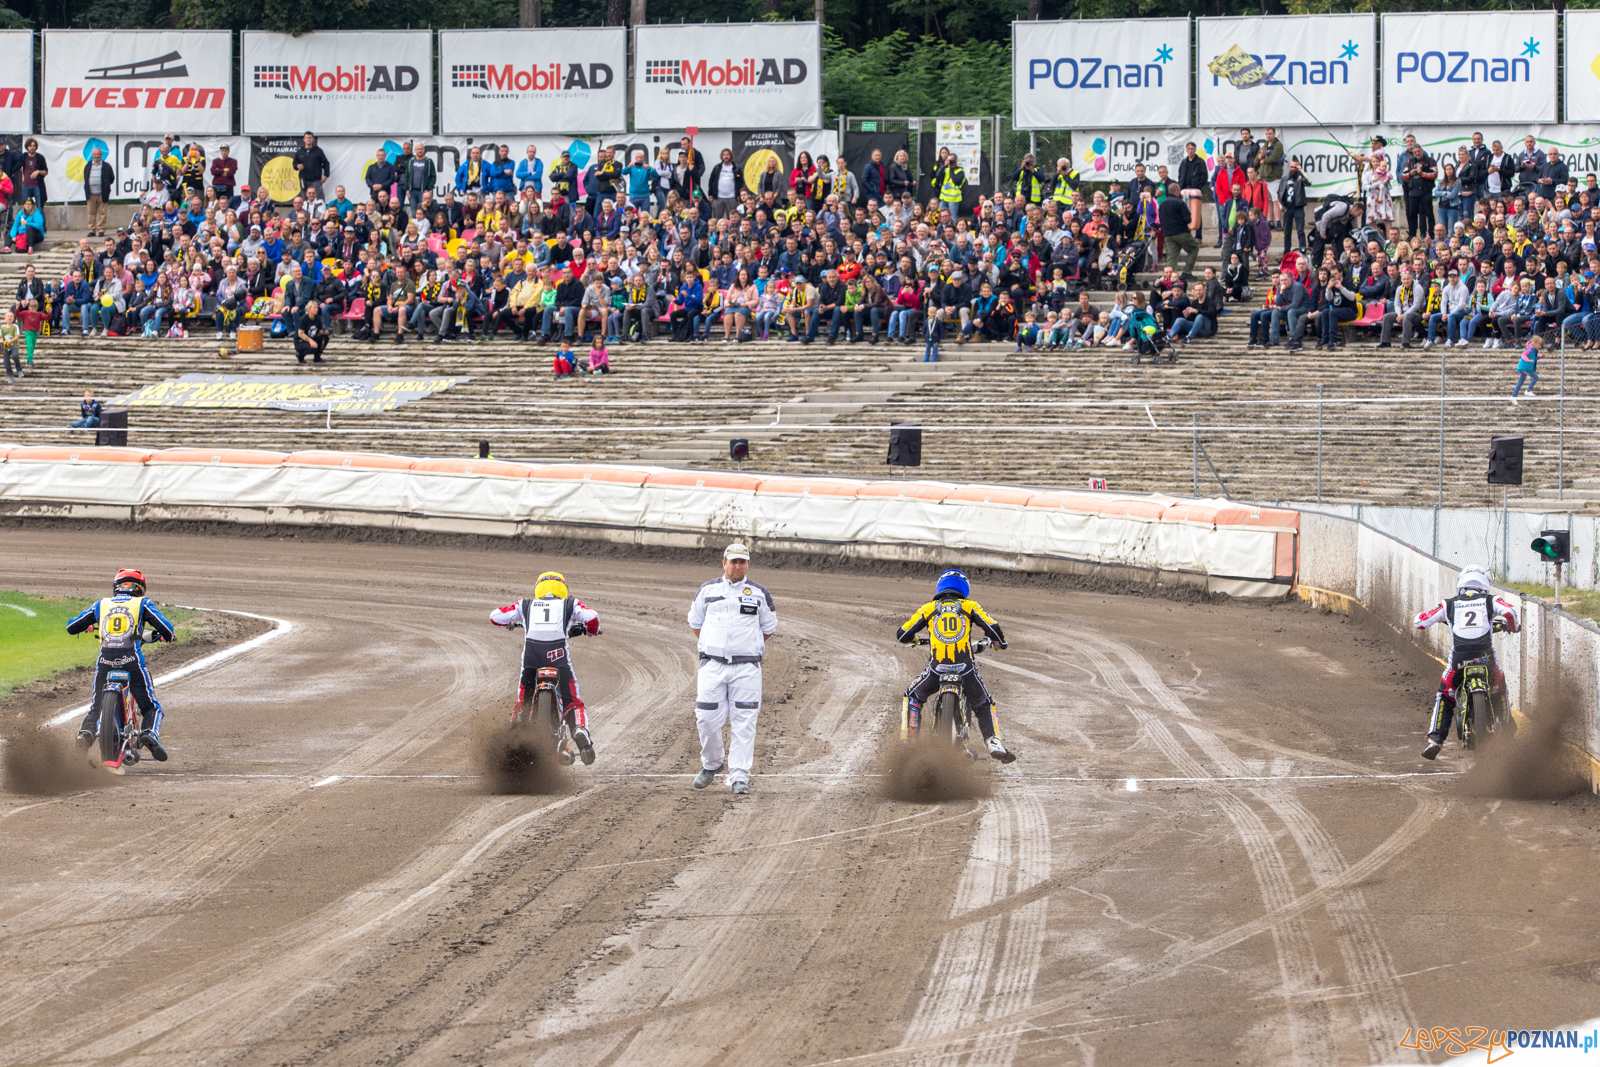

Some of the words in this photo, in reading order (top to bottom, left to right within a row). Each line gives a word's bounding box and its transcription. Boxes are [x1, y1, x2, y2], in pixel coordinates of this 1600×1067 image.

[290, 65, 420, 92] Mobil-AD
[487, 63, 614, 91] Mobil-AD
[681, 58, 808, 86] Mobil-AD
[274, 93, 323, 101] Nowoczesny
[360, 93, 395, 101] wizualny
[715, 87, 746, 95] przekaz
[744, 139, 786, 147] RESTAURACJA
[1113, 136, 1160, 163] mjp
[543, 608, 550, 622] 1
[1464, 611, 1477, 627] 2
[113, 617, 121, 632] 9
[942, 616, 957, 632] 10
